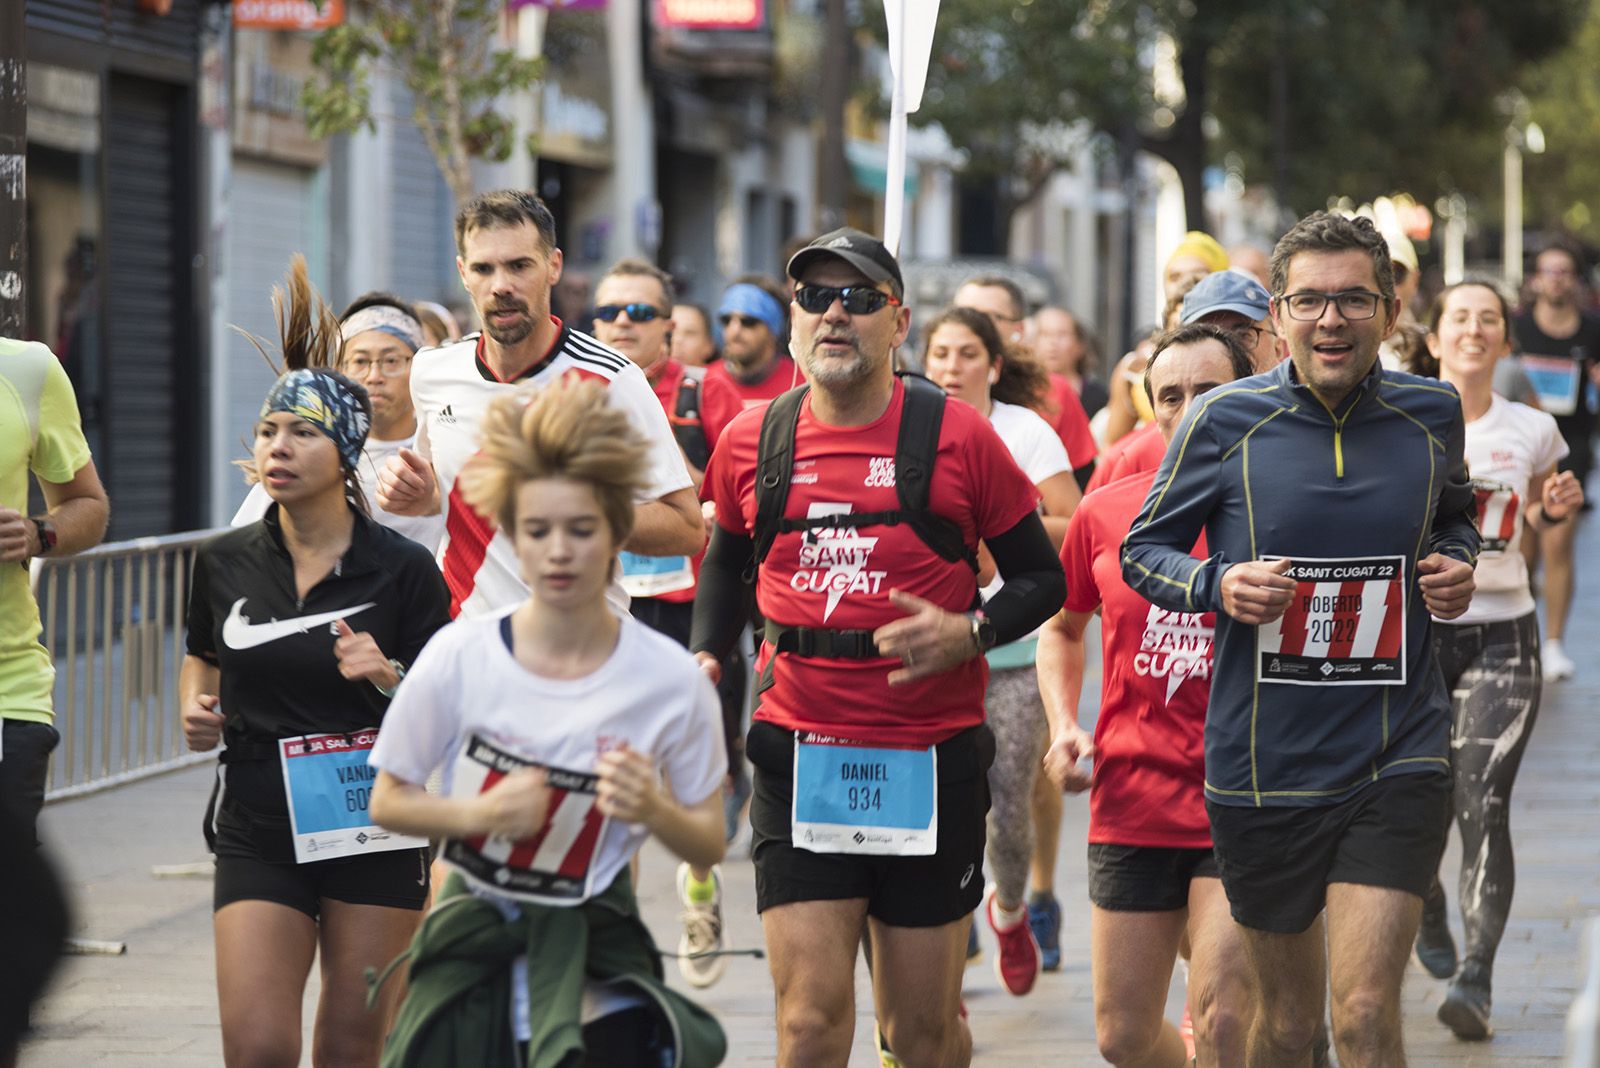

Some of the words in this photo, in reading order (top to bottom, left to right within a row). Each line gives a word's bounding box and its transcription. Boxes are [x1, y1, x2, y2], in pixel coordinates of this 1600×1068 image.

[864, 475, 896, 487] CUG
[799, 546, 872, 567] SANT
[1297, 566, 1332, 578] SANT
[1333, 565, 1376, 578] CUGAT
[1377, 565, 1394, 576] 22
[790, 571, 888, 595] CUGAT
[1302, 595, 1363, 613] ROBERTO
[1311, 618, 1356, 643] 2022
[1133, 652, 1215, 680] CUGA
[336, 764, 378, 785] VANIA
[841, 762, 889, 782] DANIEL
[848, 786, 882, 812] 934
